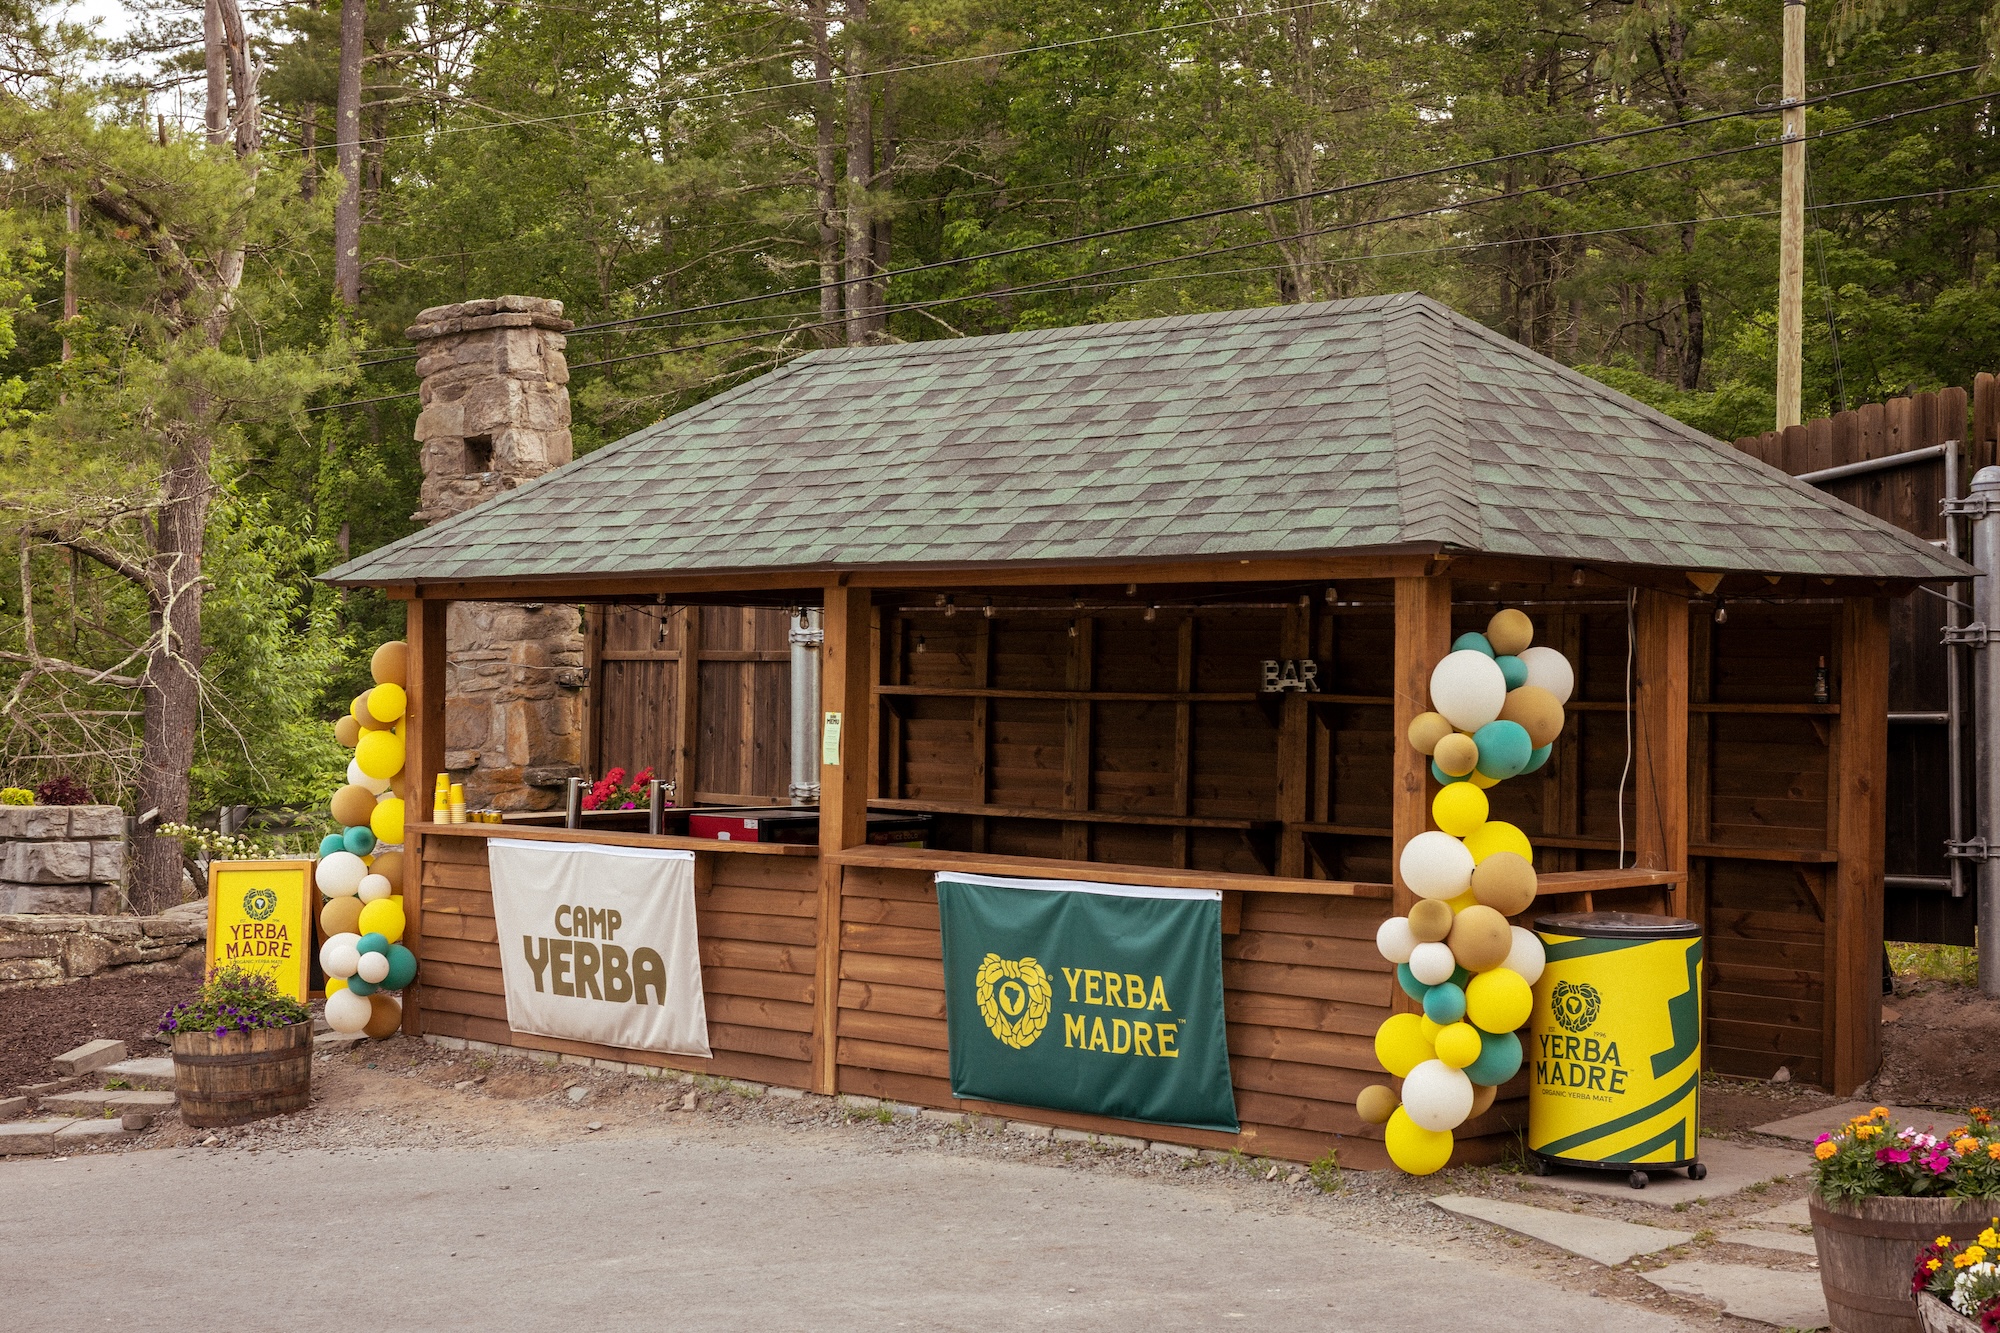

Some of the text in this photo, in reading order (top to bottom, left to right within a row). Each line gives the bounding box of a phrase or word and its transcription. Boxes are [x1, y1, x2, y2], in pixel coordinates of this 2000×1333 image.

[1262, 659, 1321, 692] BAR
[230, 923, 288, 941] YERBA
[555, 904, 622, 941] CAMP
[226, 940, 293, 959] MADRE
[523, 935, 667, 1006] YERBA
[1061, 967, 1172, 1012] YERBA
[1062, 1013, 1180, 1058] MADRE
[1539, 1034, 1622, 1067] YERBA
[1536, 1060, 1629, 1094] MADRE
[1541, 1088, 1613, 1103] ORGANIC YERBA MATE
